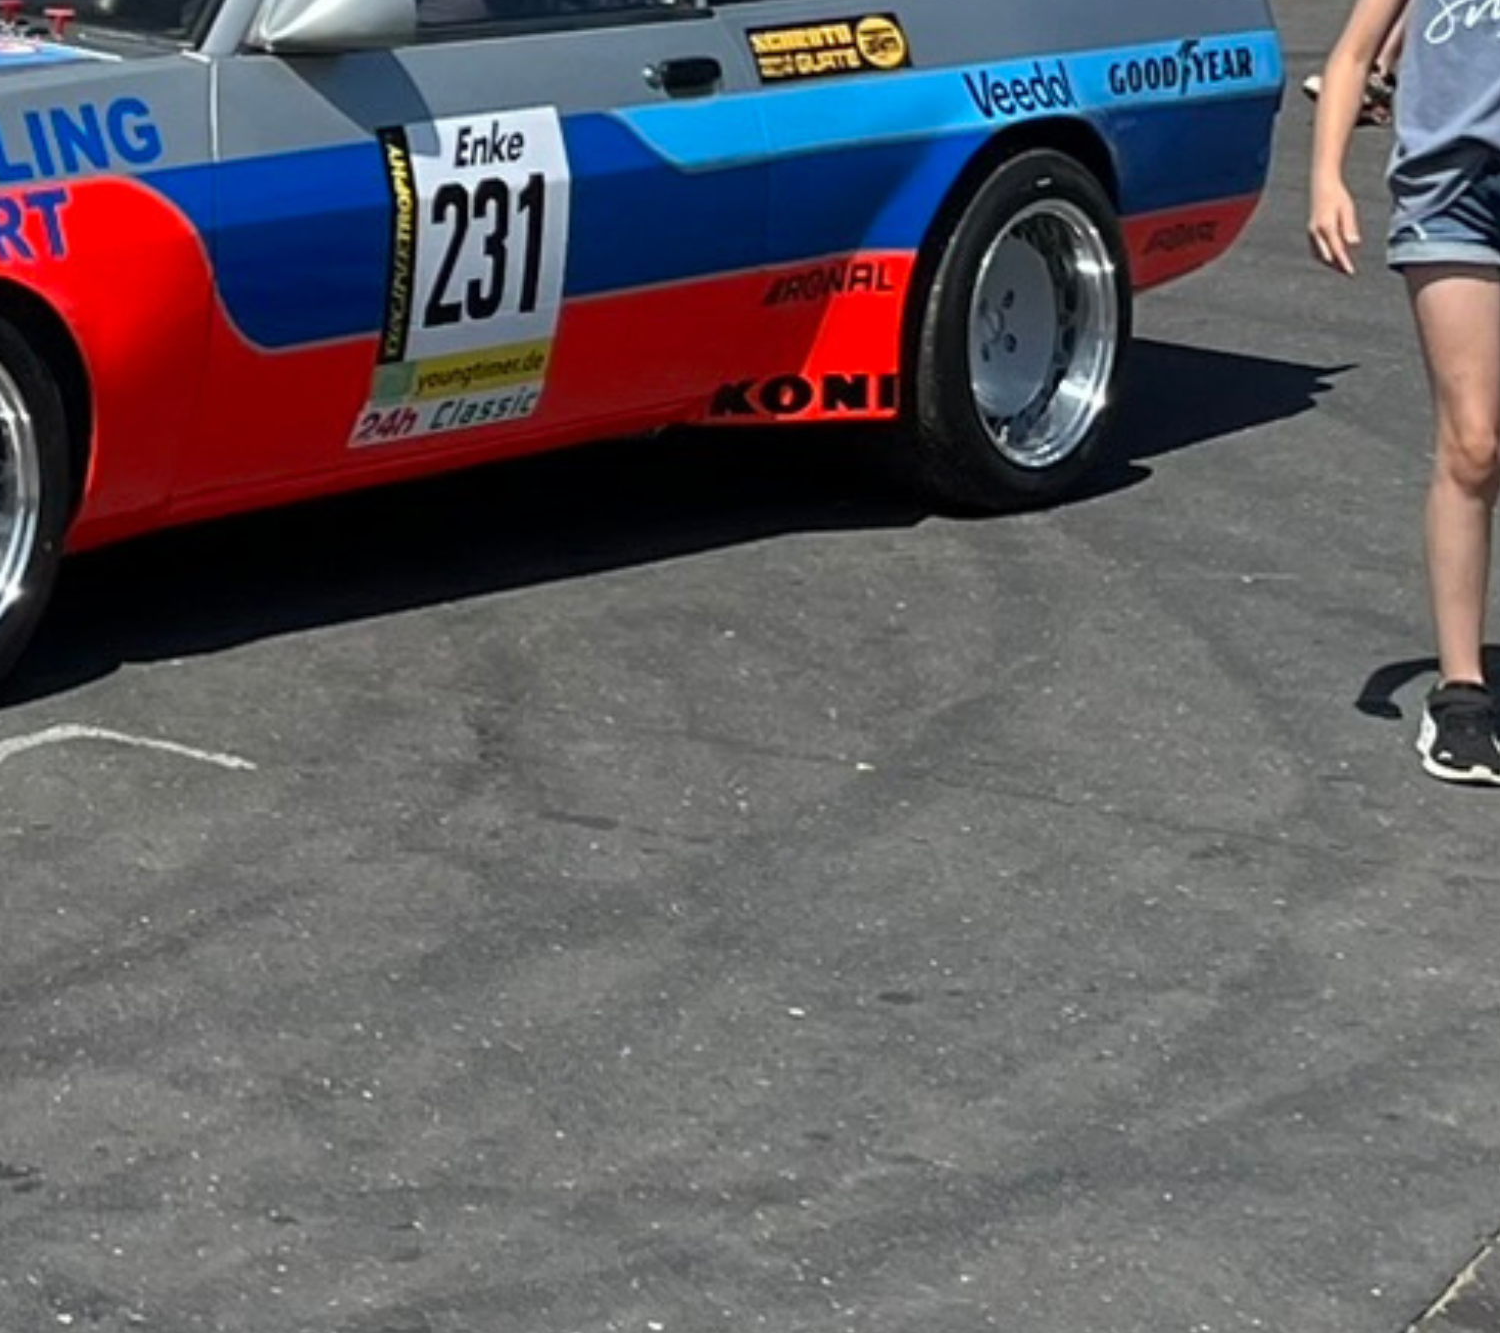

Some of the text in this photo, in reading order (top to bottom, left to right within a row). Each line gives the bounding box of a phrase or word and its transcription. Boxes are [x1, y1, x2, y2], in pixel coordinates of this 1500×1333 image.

[962, 40, 1253, 119] Veedol GOODYEAR
[454, 121, 525, 169] Enke
[422, 172, 546, 329] 231
[778, 262, 893, 304] RONAL
[416, 349, 546, 397] youngtimer.de
[710, 374, 898, 418] KONI
[429, 384, 537, 431] Classic
